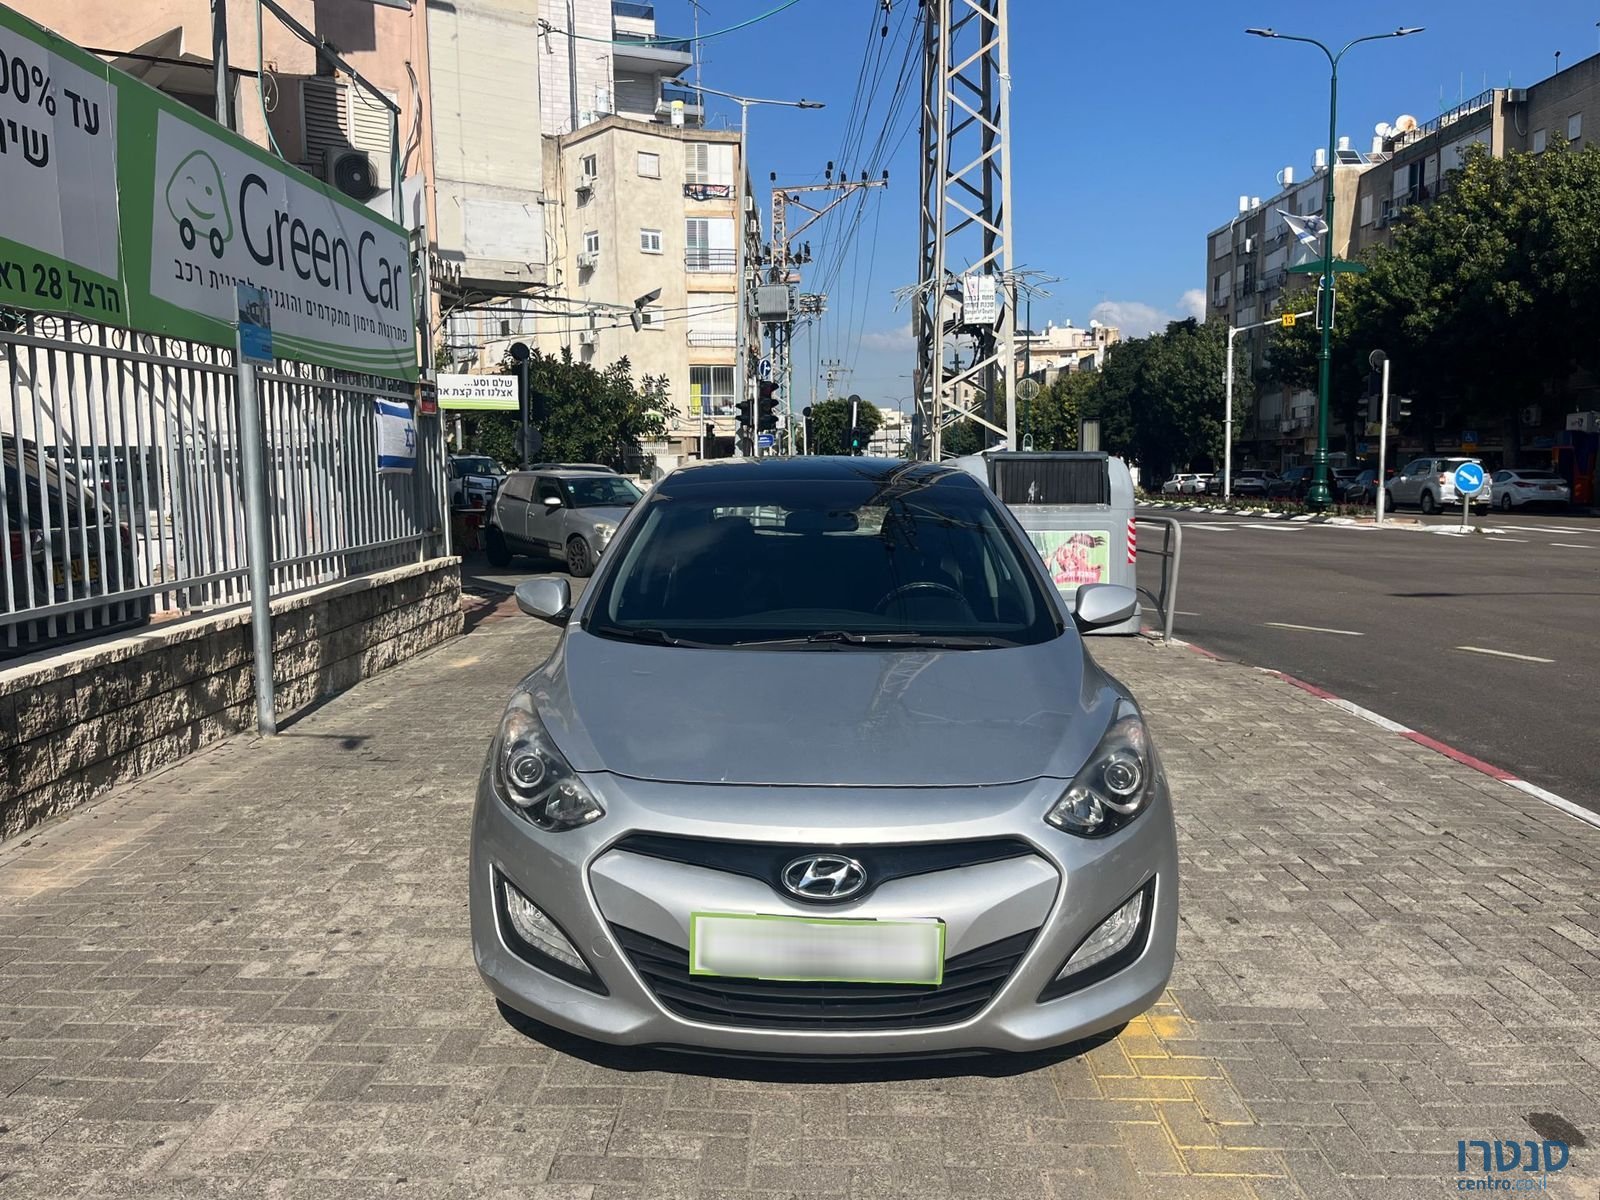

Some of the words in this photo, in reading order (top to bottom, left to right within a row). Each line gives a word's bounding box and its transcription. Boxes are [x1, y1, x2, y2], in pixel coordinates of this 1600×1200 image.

[64, 88, 99, 135] עד
[239, 173, 351, 295] Green
[358, 230, 402, 312] Car
[33, 263, 62, 300] 28
[174, 259, 203, 286] רכב
[68, 270, 120, 313] הרצל
[306, 300, 350, 327] מתקדמים
[353, 314, 376, 334] מימון
[1284, 316, 1294, 325] 13
[452, 388, 472, 398] קצת
[475, 388, 485, 396] זה
[487, 388, 513, 397] אצלנו
[492, 378, 512, 387] שלם
